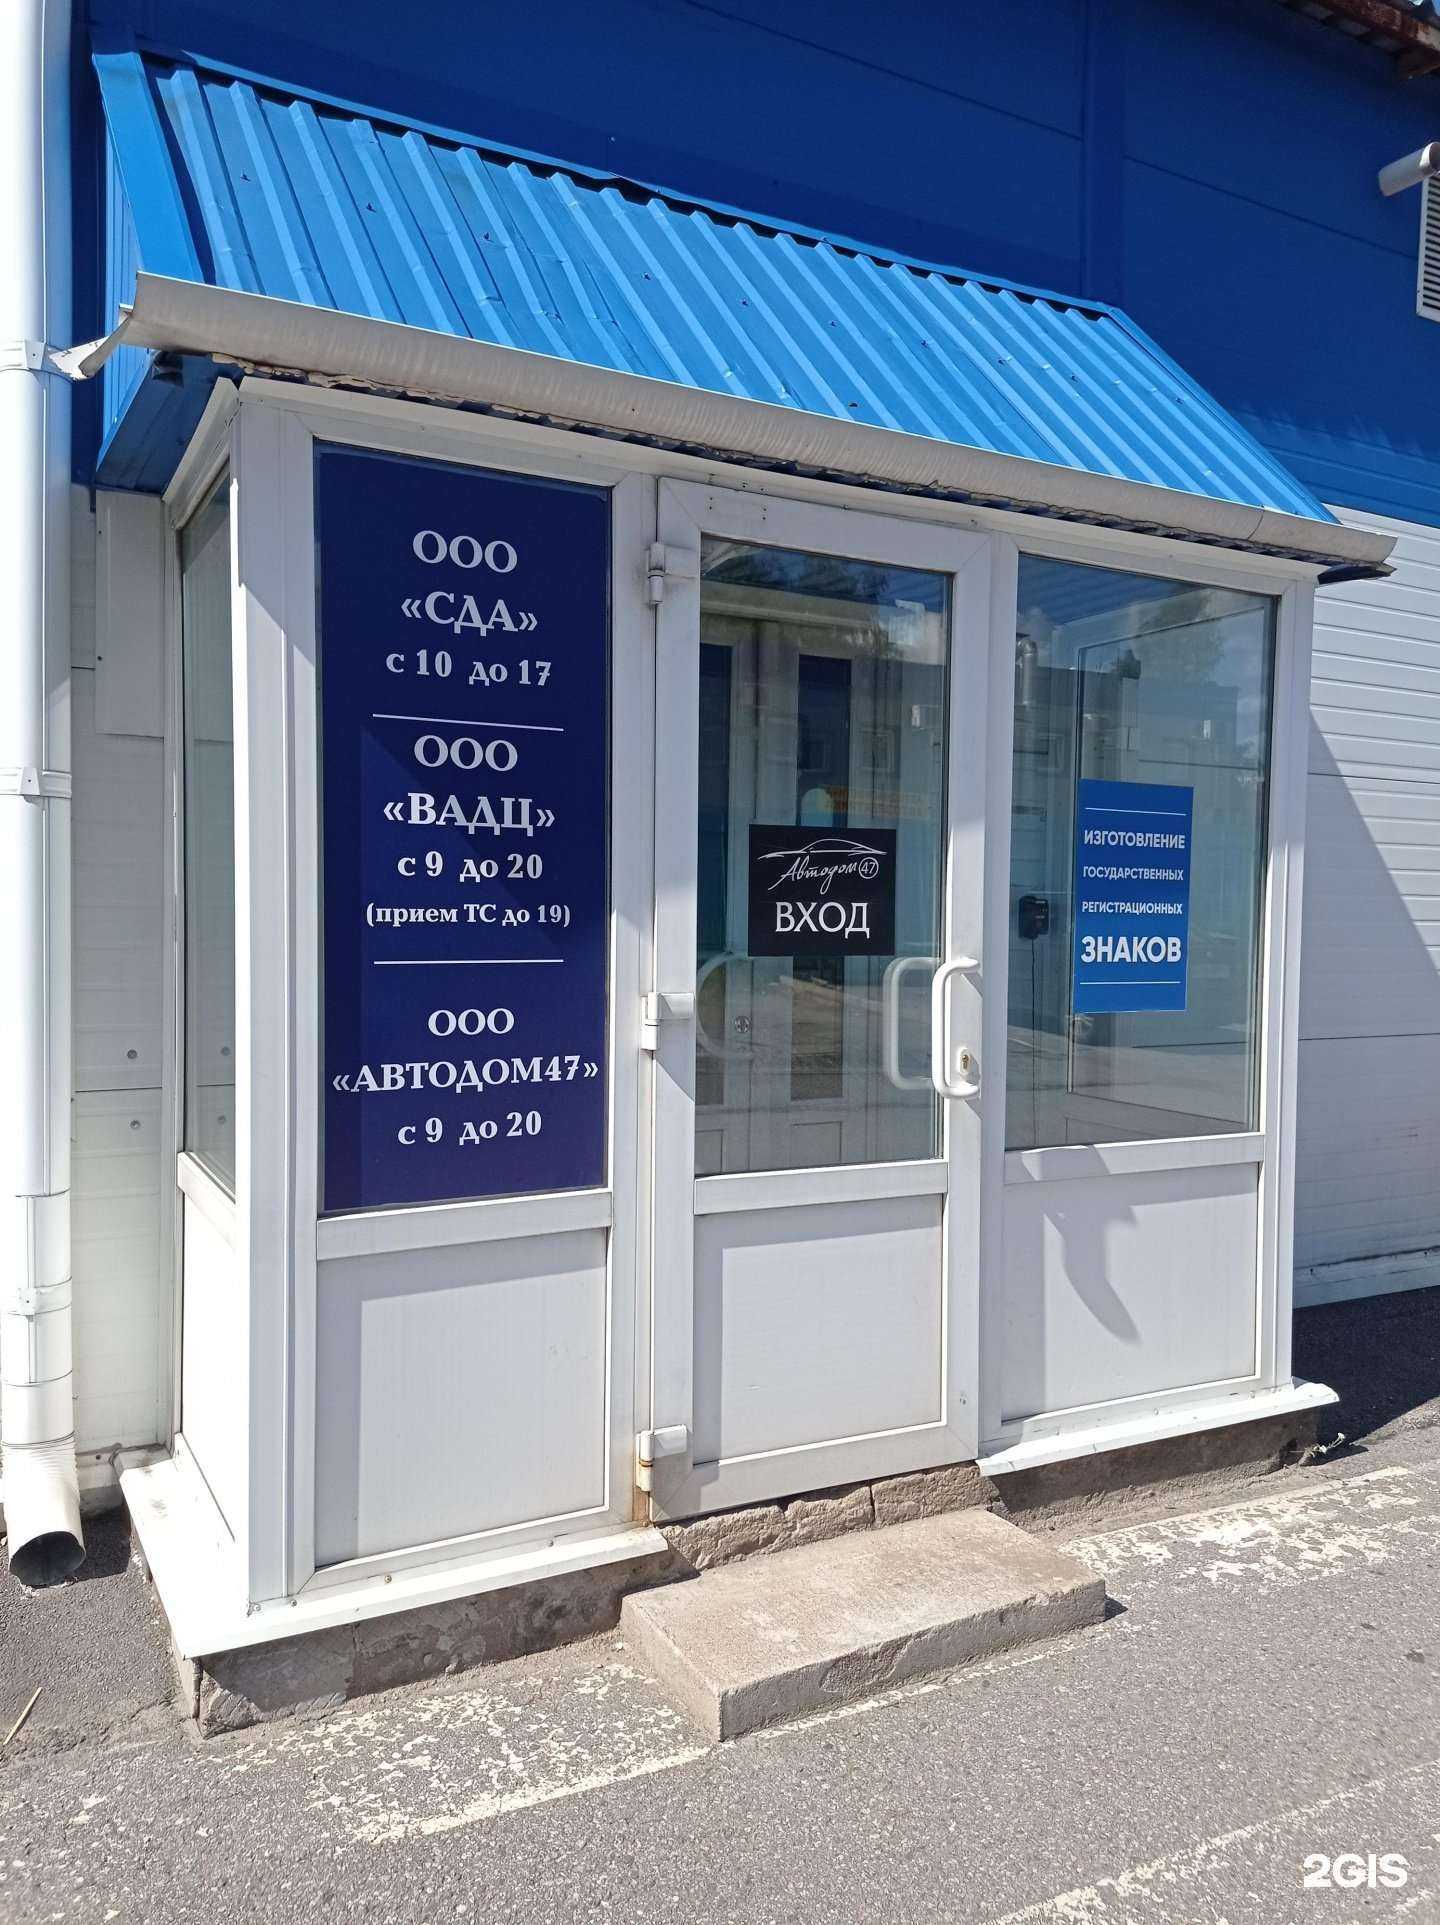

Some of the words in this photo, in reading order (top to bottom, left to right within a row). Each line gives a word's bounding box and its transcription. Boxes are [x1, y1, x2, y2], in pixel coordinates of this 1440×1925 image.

[412, 530, 518, 573] ООО
[401, 591, 538, 636] «СДА»
[386, 652, 405, 673] с
[416, 649, 452, 677] 10
[468, 661, 508, 686] до
[518, 659, 552, 686] 17
[414, 734, 518, 771] ООО
[383, 792, 556, 836] «ВАДЦ»
[1084, 830, 1186, 849] ИЗГОТОВЛЕНИЕ
[397, 856, 416, 877] с
[425, 851, 443, 877] 9
[459, 858, 499, 882] до
[507, 854, 543, 879] 20
[767, 855, 858, 895] Автодом
[860, 859, 877, 876] 47
[1083, 866, 1184, 881] ГОСУДАРСТВЕННЫХ
[366, 903, 458, 927] (прием
[464, 904, 497, 923] ТС
[502, 908, 530, 926] до
[537, 904, 571, 927] 19)
[775, 901, 870, 939] ВХОД
[1082, 901, 1183, 915] РЕГИСТРАЦИОННЫХ
[1081, 936, 1182, 963] ЗНАКОВ
[428, 1008, 515, 1036] ООО
[332, 1055, 599, 1093] «АВТОДОМ47»
[397, 1123, 416, 1144] с
[425, 1117, 443, 1142] 9
[459, 1119, 498, 1146] до
[506, 1110, 542, 1137] 20
